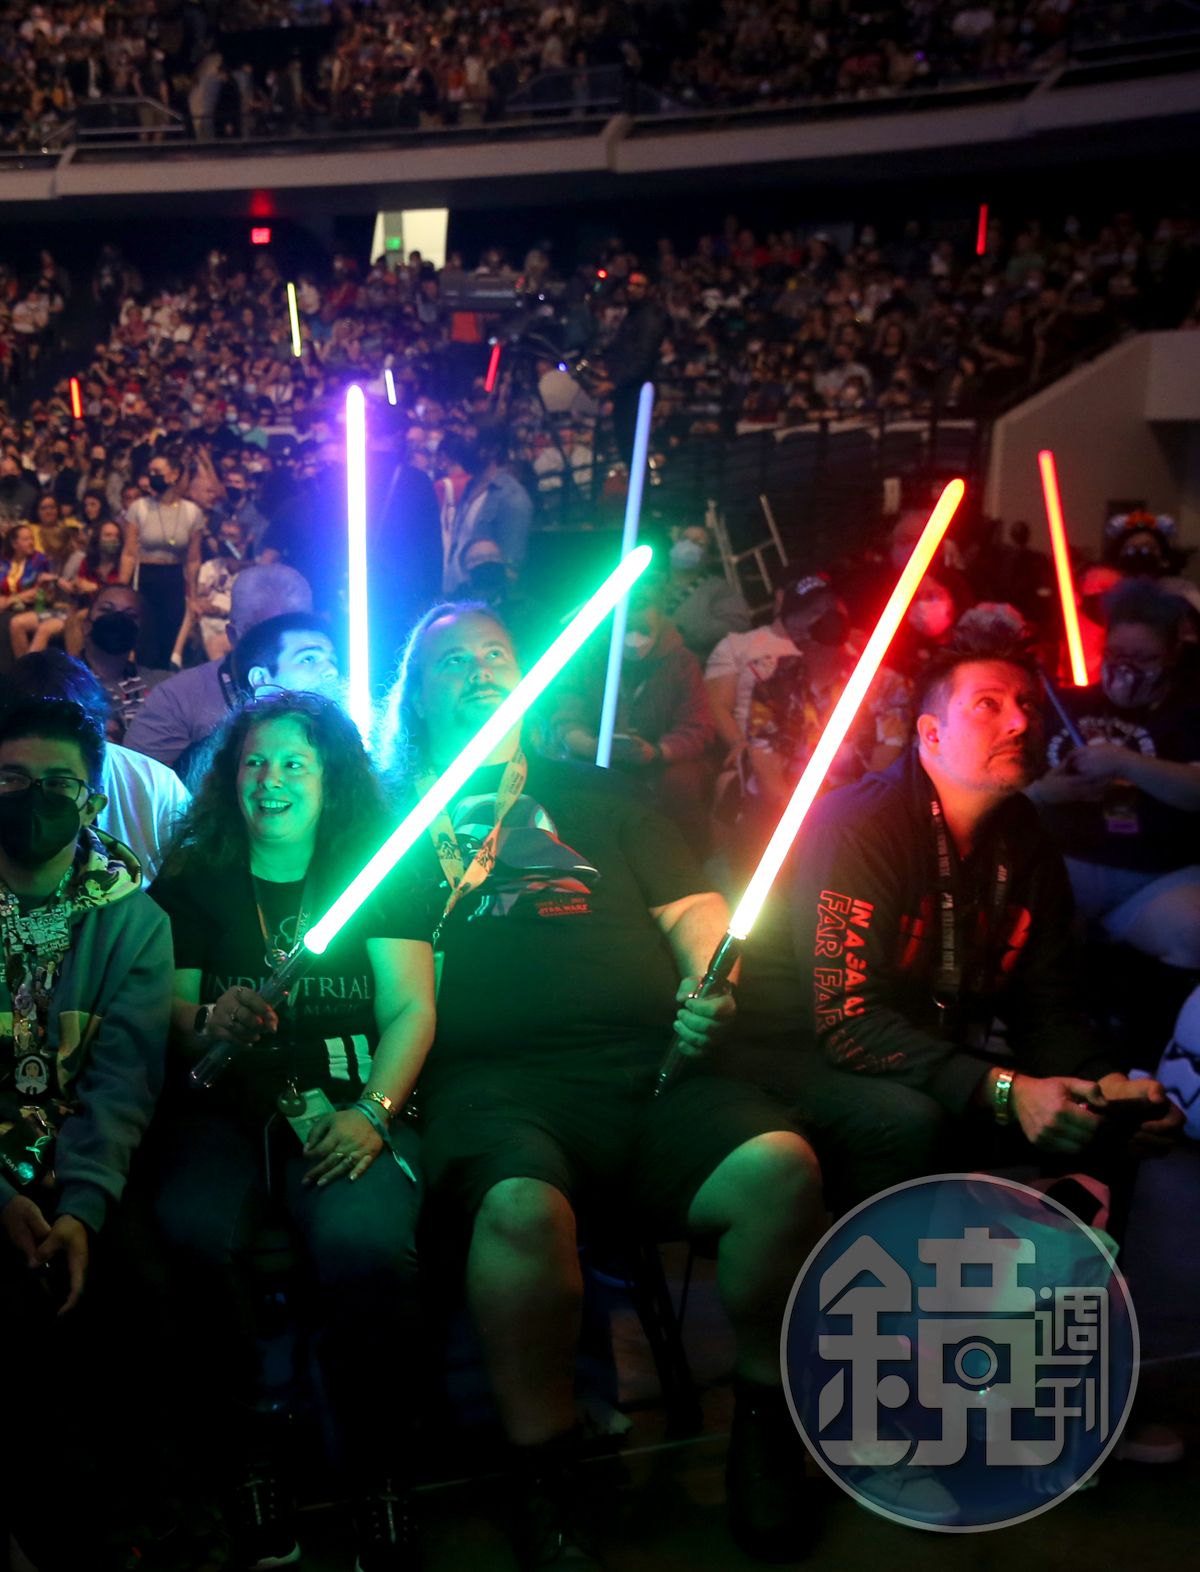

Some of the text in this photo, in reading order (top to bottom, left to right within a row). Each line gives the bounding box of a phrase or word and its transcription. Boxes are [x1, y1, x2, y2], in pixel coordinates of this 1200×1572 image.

[814, 890, 852, 958] FAR
[849, 899, 875, 929] IN
[844, 929, 866, 948] A
